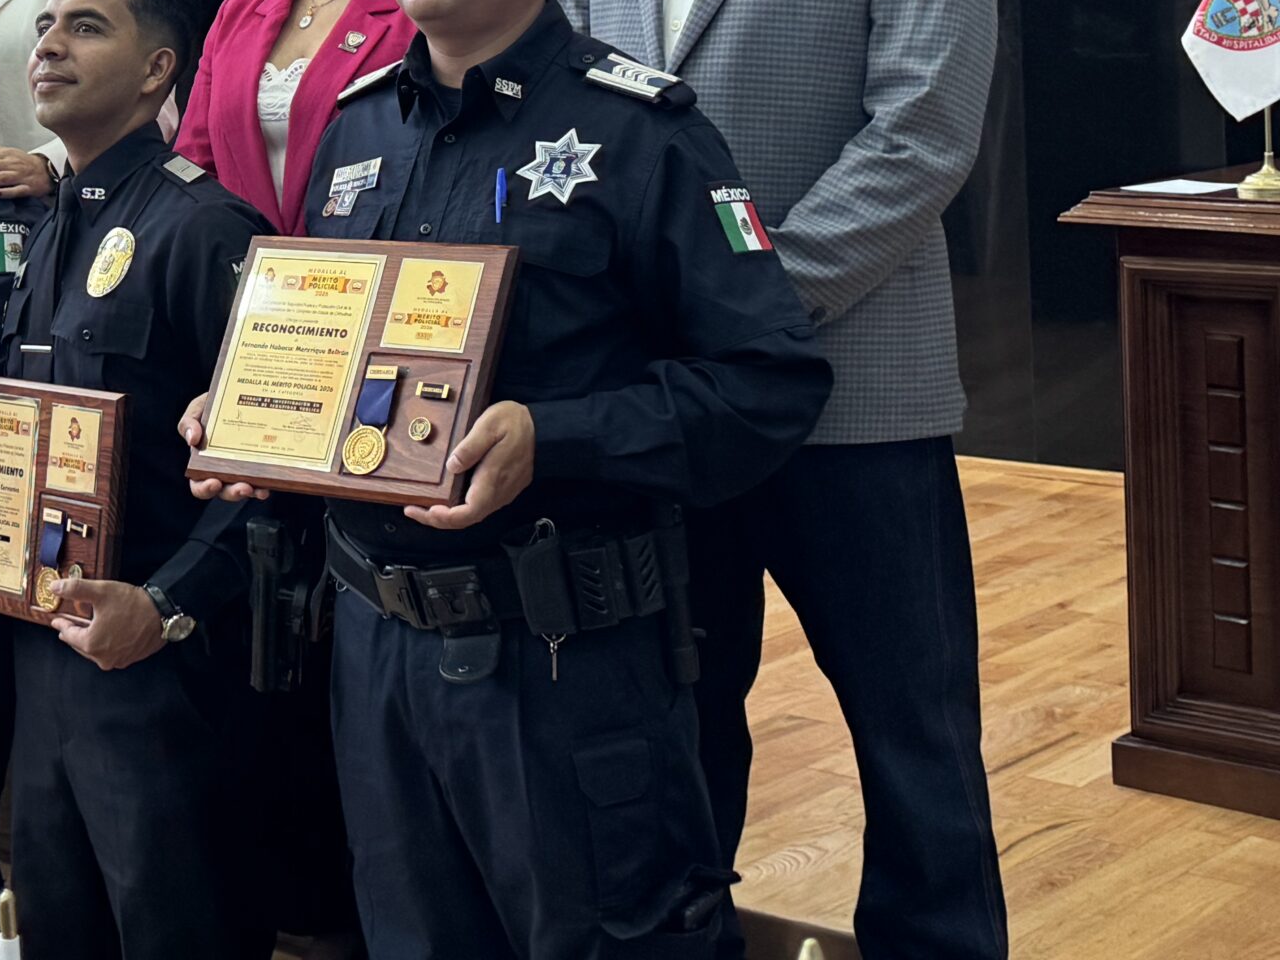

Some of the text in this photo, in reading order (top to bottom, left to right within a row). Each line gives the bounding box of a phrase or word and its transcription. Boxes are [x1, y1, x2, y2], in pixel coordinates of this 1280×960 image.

[710, 186, 751, 203] MÉXICO
[308, 282, 339, 291] POLICIAL
[252, 322, 348, 338] RECONOCIMIENTO
[237, 377, 262, 386] MEDALLA
[293, 382, 319, 391] POLICIAL
